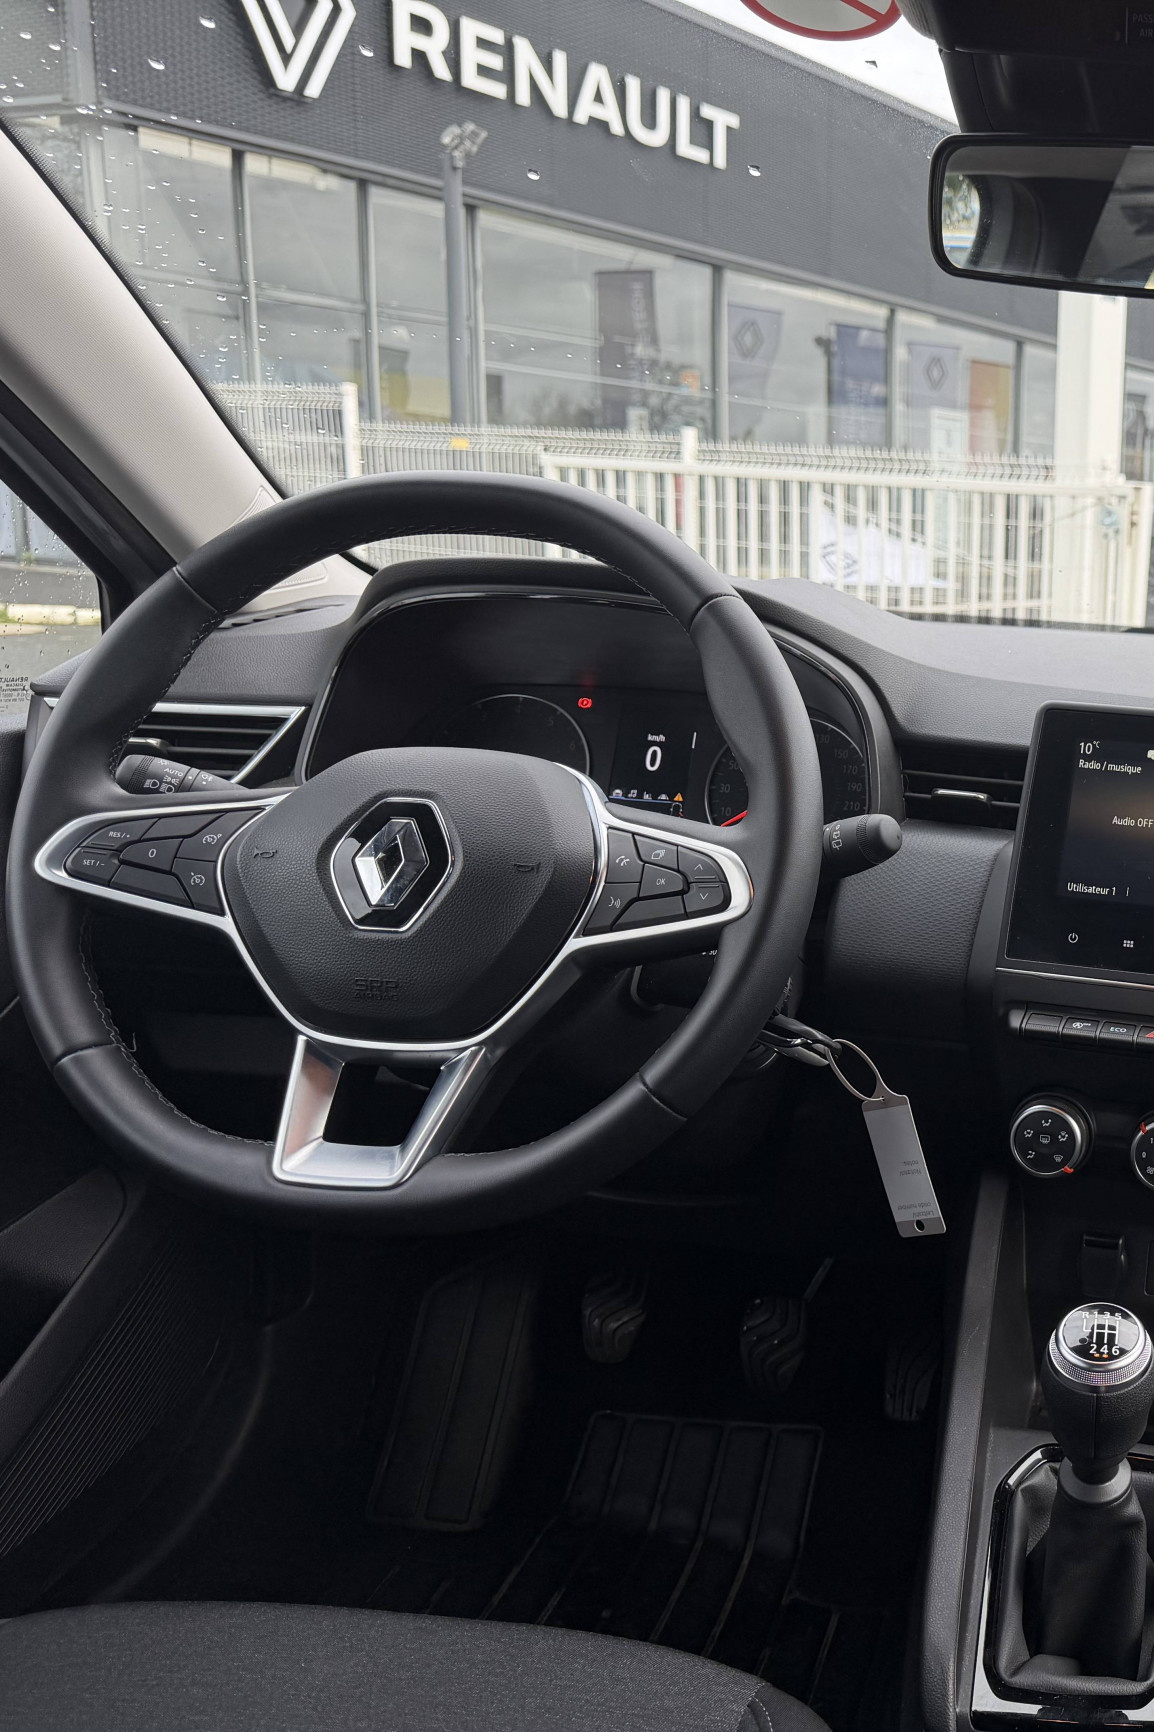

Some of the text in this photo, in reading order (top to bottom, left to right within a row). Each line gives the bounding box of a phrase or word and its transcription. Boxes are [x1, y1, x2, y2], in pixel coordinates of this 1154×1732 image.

[1140, 28, 1153, 38] AIR
[391, 0, 740, 170] RENAULT
[647, 733, 665, 742] km/h
[645, 745, 662, 772] 0
[834, 749, 849, 759] 150
[164, 767, 184, 777] AUTO
[842, 764, 858, 775] 170
[1079, 759, 1101, 770] Radio
[1107, 763, 1142, 775] musique
[719, 783, 731, 793] 30
[847, 782, 862, 792] 190
[843, 801, 860, 811] 210
[720, 807, 732, 817] 10
[1112, 815, 1154, 828] Audio OFF
[656, 878, 666, 886] OK
[1067, 882, 1109, 896] Utilisateur
[1089, 1344, 1120, 1355] 2 4 6
